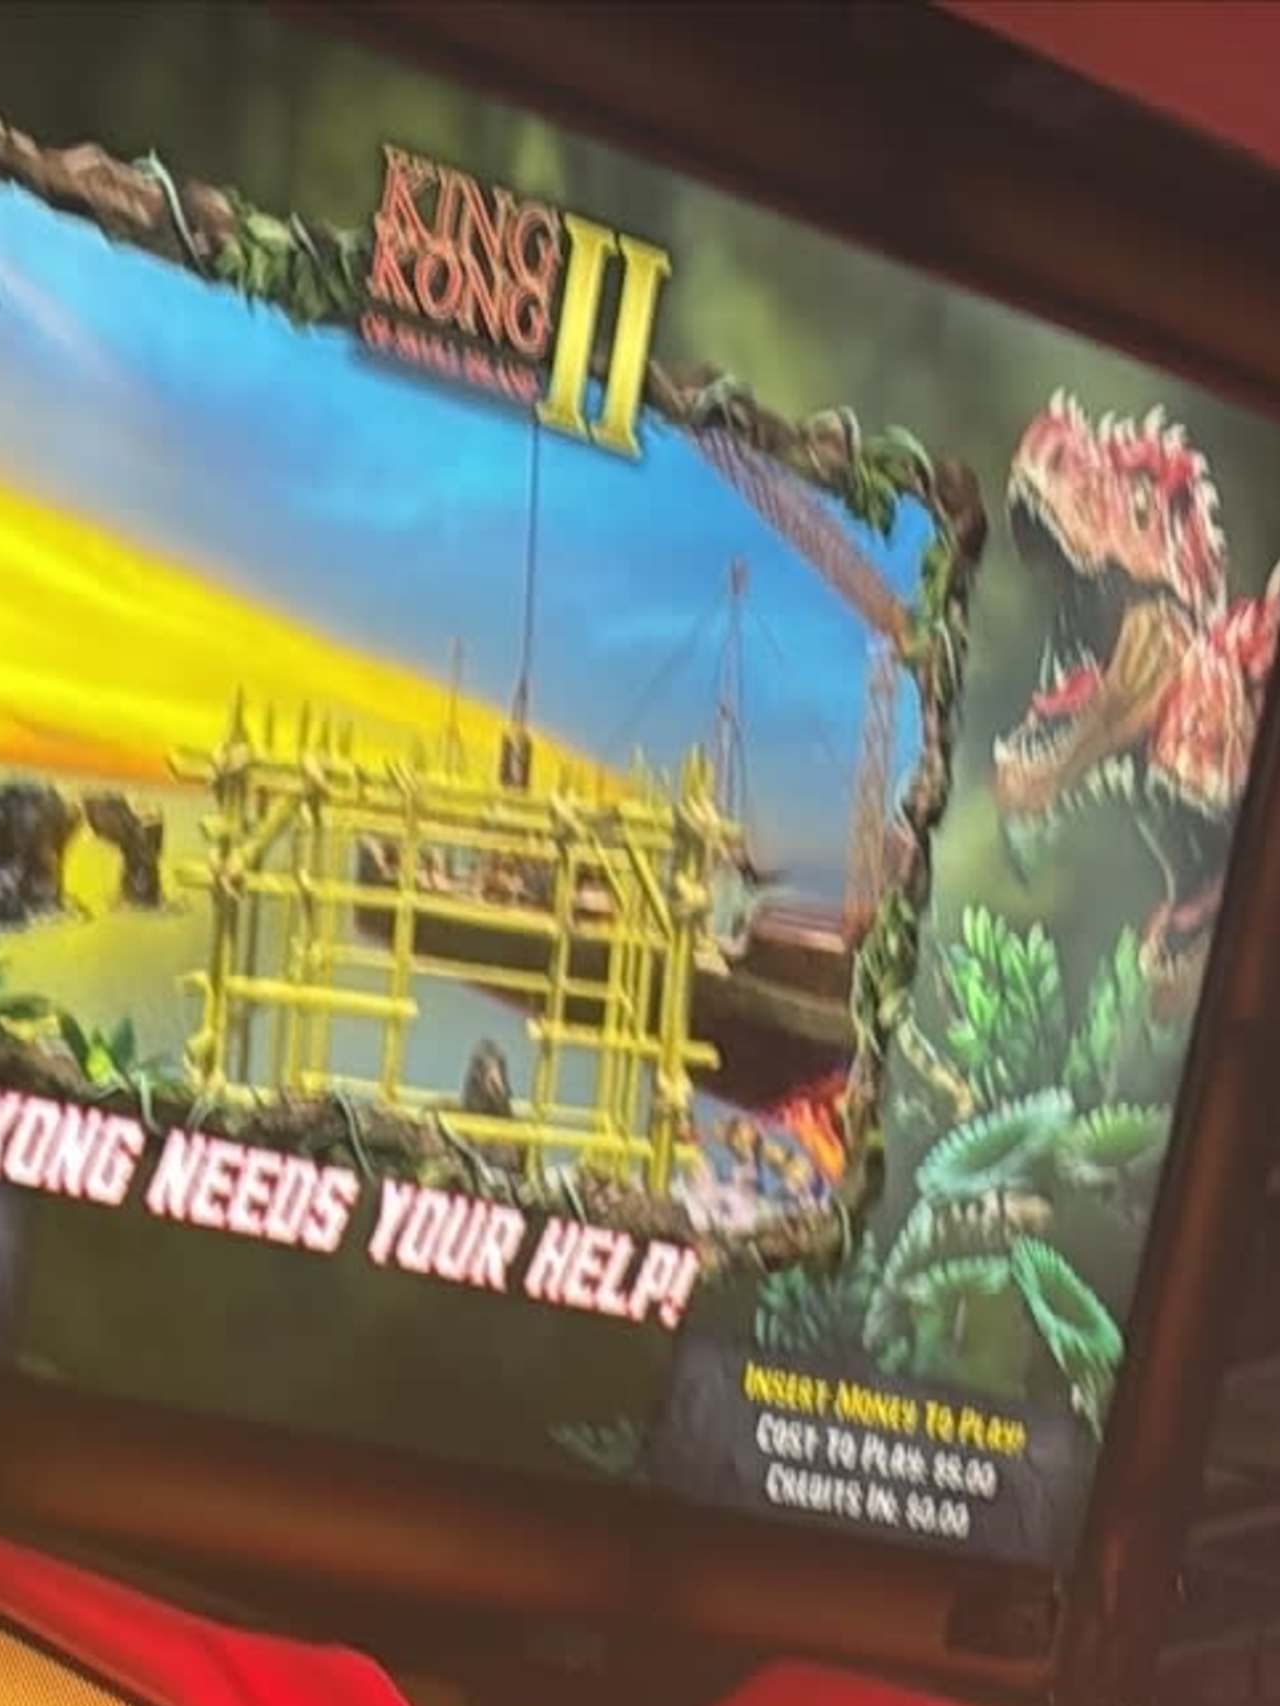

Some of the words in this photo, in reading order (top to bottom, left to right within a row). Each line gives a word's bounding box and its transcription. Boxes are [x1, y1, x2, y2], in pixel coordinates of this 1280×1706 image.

[366, 210, 552, 356] KONG
[379, 143, 561, 288] KING
[535, 212, 671, 460] II
[145, 1128, 361, 1254] NEEDS
[367, 1177, 525, 1292] YOUR
[523, 1218, 702, 1331] HELP!
[744, 1359, 831, 1416] INSERT
[835, 1379, 919, 1436] MONEY
[925, 1400, 954, 1443] TO
[756, 1411, 819, 1461] COST
[827, 1426, 857, 1471] TO
[766, 1462, 863, 1519] CREDITS
